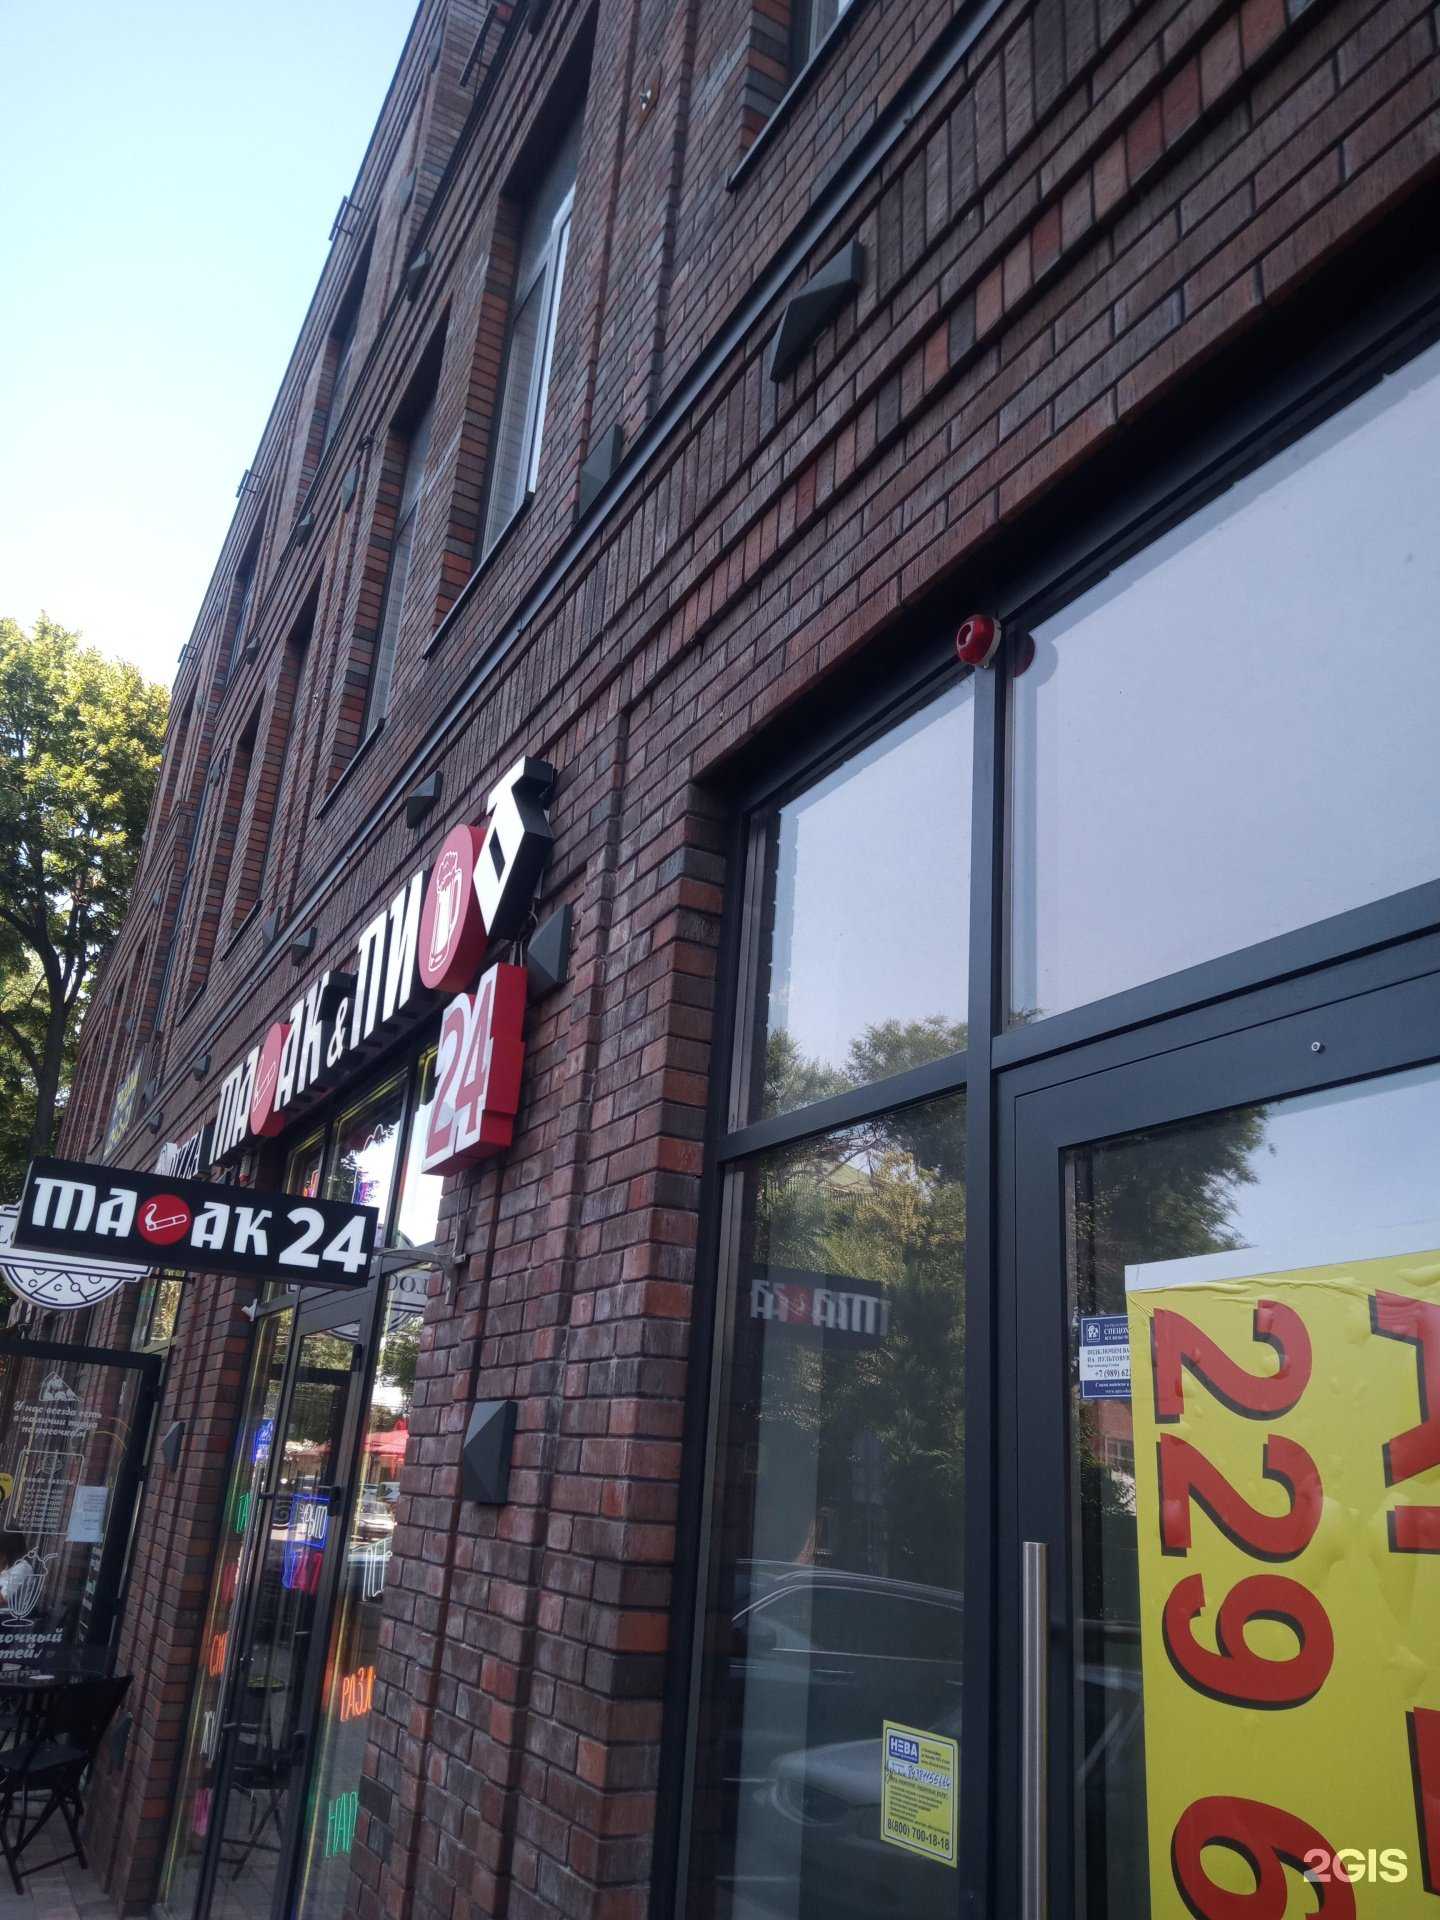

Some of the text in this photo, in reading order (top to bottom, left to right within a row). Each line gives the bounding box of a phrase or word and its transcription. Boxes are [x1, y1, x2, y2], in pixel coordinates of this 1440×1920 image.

[327, 997, 349, 1067] &
[424, 968, 497, 1168] 24
[278, 1206, 368, 1273] 24
[1152, 1300, 1334, 1711] 229
